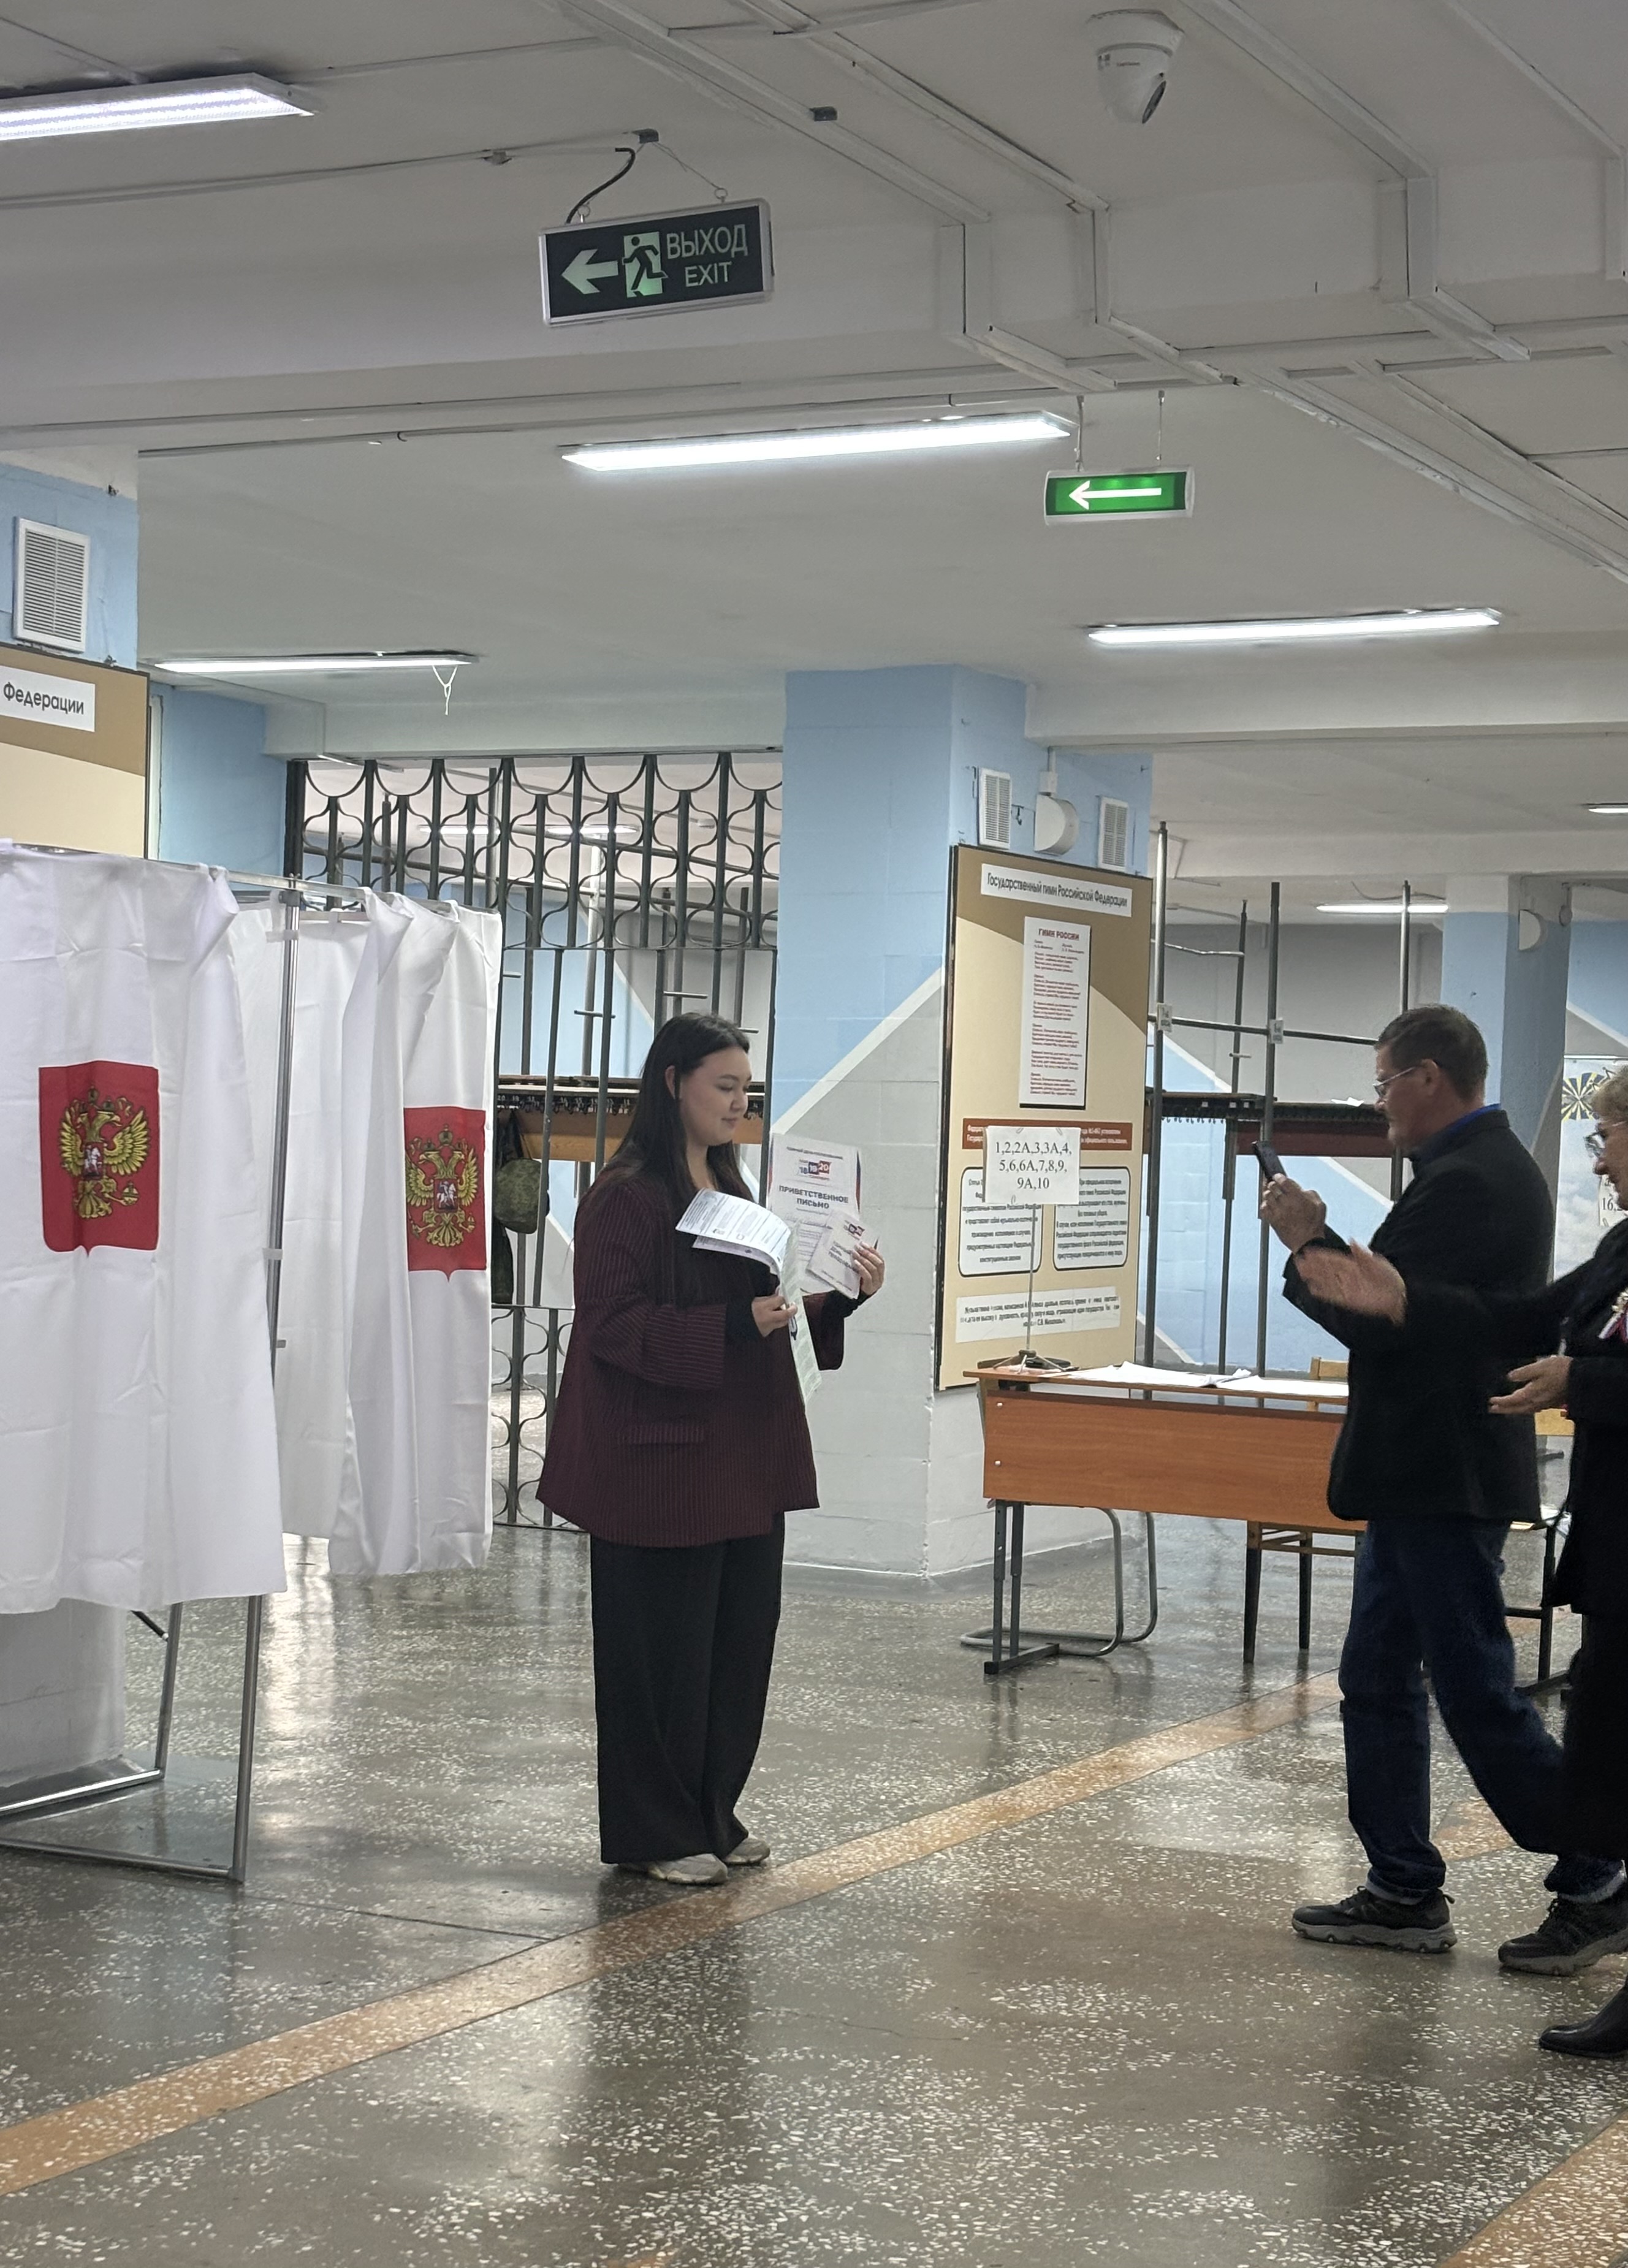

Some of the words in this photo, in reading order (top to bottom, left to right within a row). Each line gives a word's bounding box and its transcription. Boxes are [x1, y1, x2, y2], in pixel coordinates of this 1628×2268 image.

[666, 224, 748, 259] ВЫХОД
[685, 261, 732, 287] EXIT
[3, 682, 84, 715] Федерации
[987, 872, 1042, 894] Государственный
[1043, 884, 1057, 895] гимн
[1057, 884, 1094, 902] Российской
[1094, 890, 1128, 907] Федерации
[779, 1185, 849, 1203] ПРИВЕТСТВЕННОЕ
[1017, 1177, 1049, 1190] 9А,10
[797, 1198, 829, 1209] ПИСЬМО
